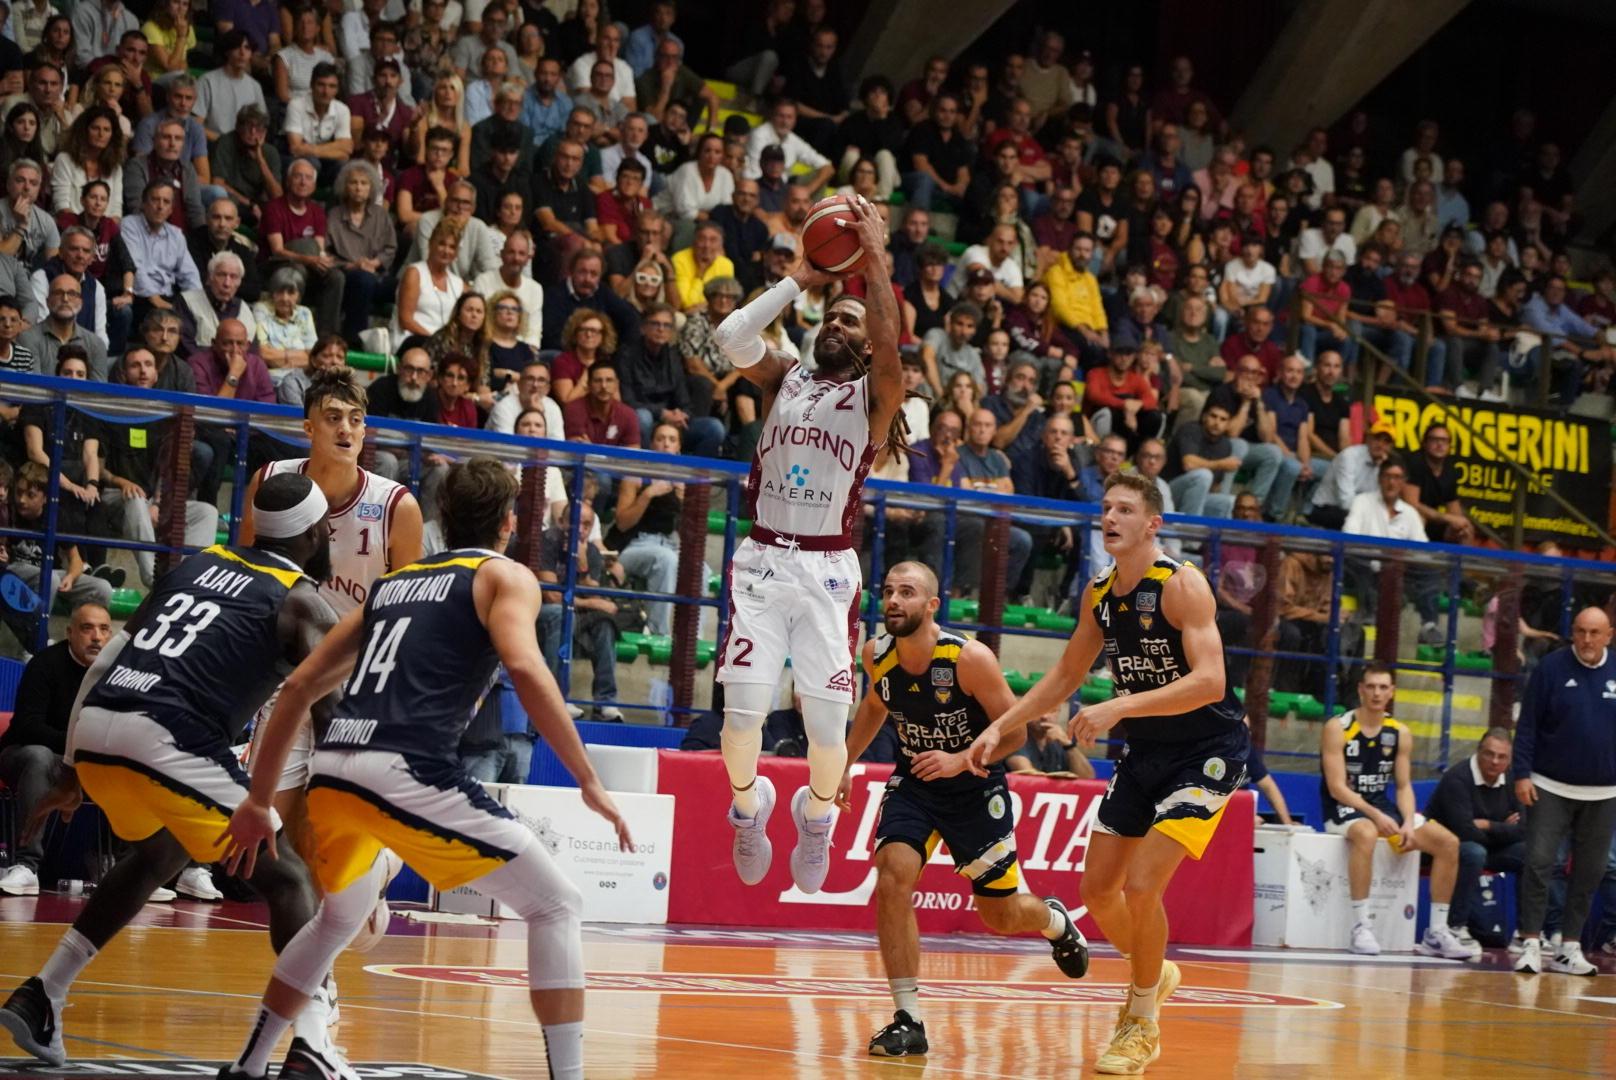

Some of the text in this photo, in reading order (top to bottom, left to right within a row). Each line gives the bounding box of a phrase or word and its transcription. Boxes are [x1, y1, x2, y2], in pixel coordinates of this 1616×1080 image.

[835, 384, 856, 410] 2
[760, 425, 855, 471] LIVORNO
[764, 480, 833, 502] AKERN
[1455, 463, 1554, 495] OBILIRE
[357, 528, 370, 556] 1
[193, 565, 254, 598] AJAYI
[372, 573, 456, 611] MONTANO
[133, 592, 221, 658] 33
[349, 617, 412, 696] 14
[732, 638, 754, 667] 2
[1118, 656, 1178, 673] REALE
[105, 665, 162, 693] TORINO
[881, 677, 891, 702] 8
[323, 718, 378, 745] TORINO
[906, 720, 972, 739] REALE
[910, 735, 974, 750] MUTUA
[568, 837, 656, 855] Toscana ood
[911, 890, 962, 911] ORNO
